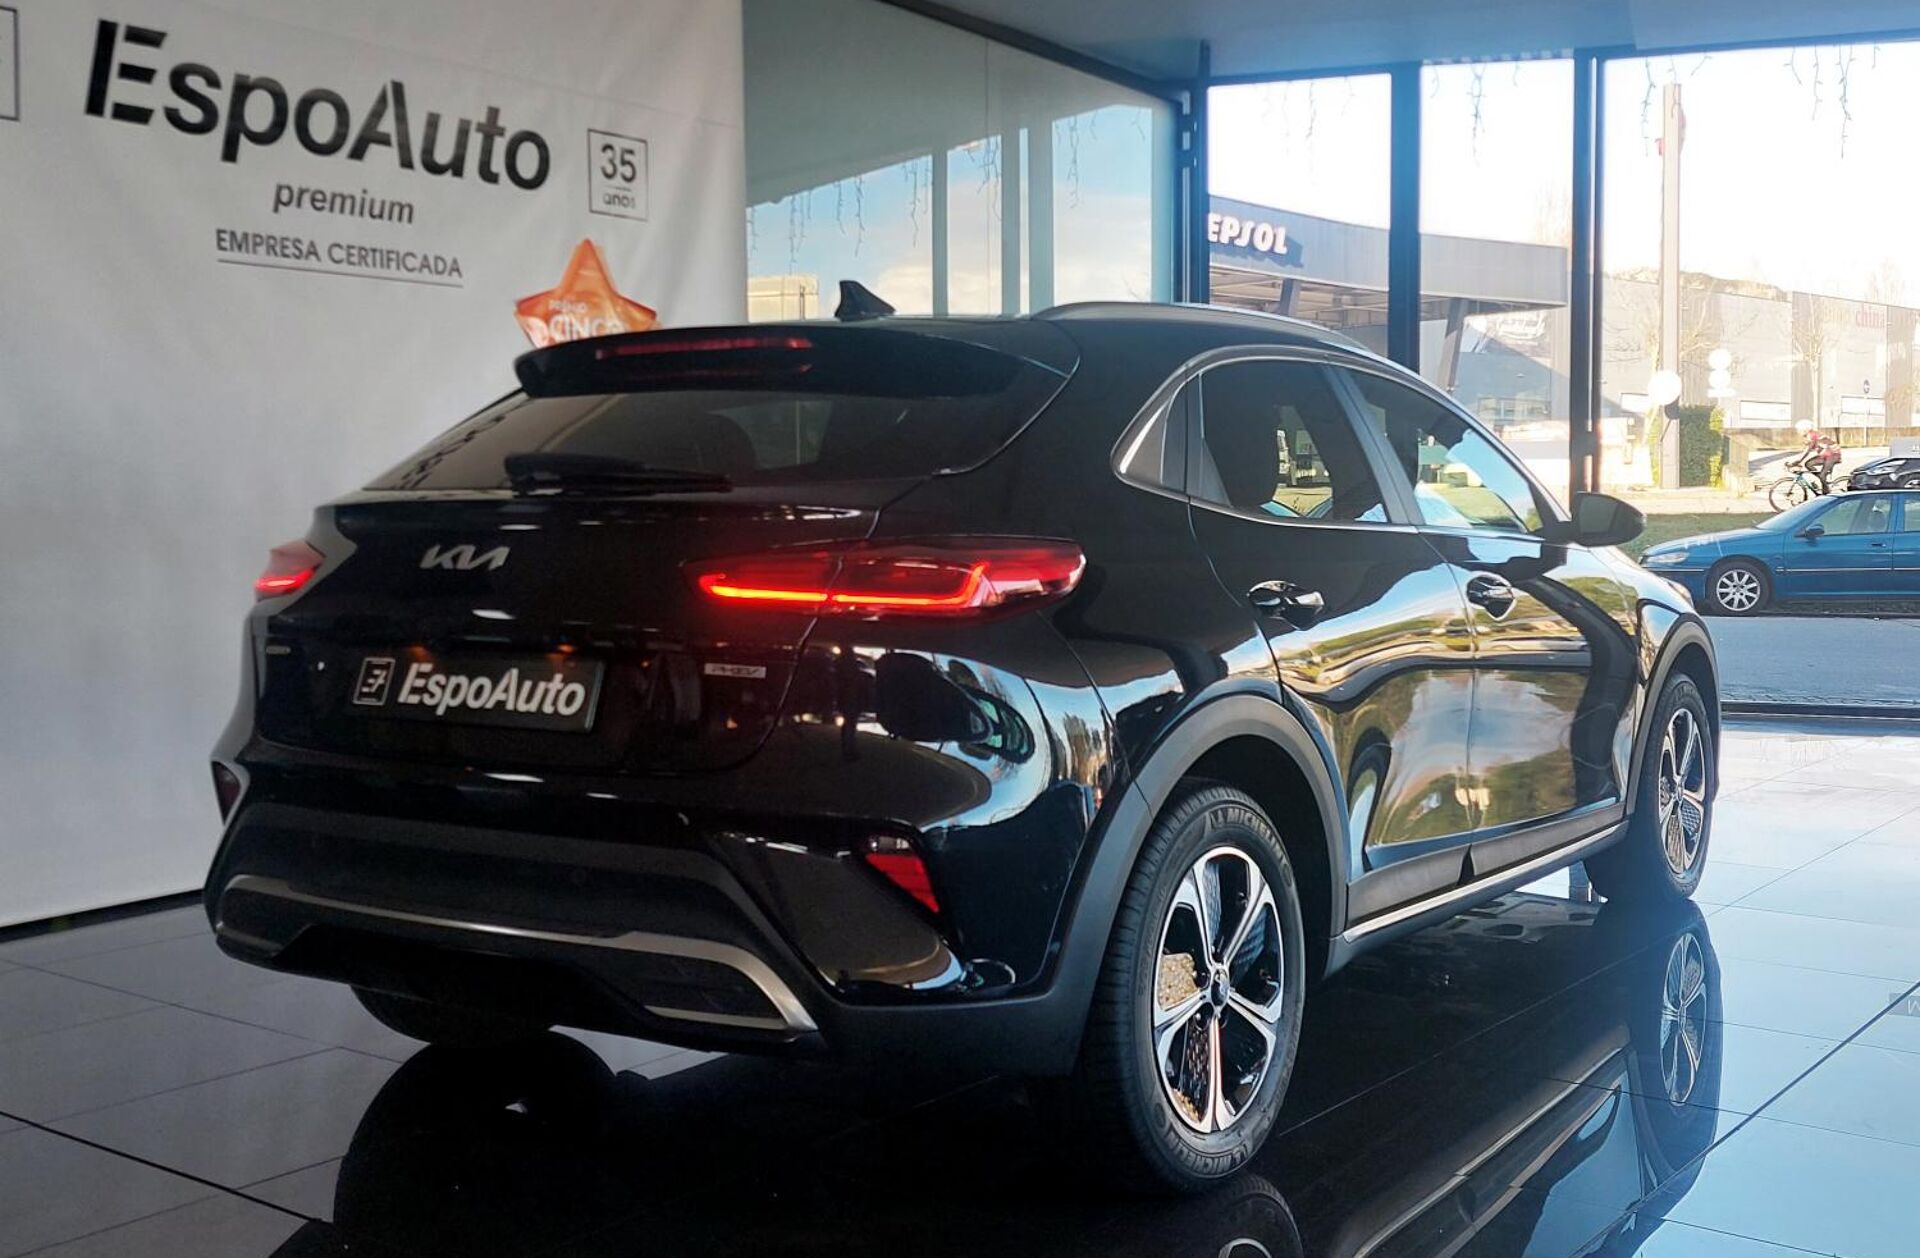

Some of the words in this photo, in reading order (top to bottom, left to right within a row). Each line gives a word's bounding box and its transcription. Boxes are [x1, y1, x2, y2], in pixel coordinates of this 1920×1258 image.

[84, 18, 551, 191] EspoAuto
[601, 143, 636, 183] 35
[272, 182, 414, 224] premium
[603, 193, 635, 209] anos
[215, 228, 321, 263] EMPRESA
[327, 242, 463, 278] CERTIFICADA
[1207, 212, 1288, 255] EPSOL
[420, 543, 510, 571] KIA
[398, 662, 586, 717] EspoAuto
[1226, 806, 1284, 862] MICHELIN
